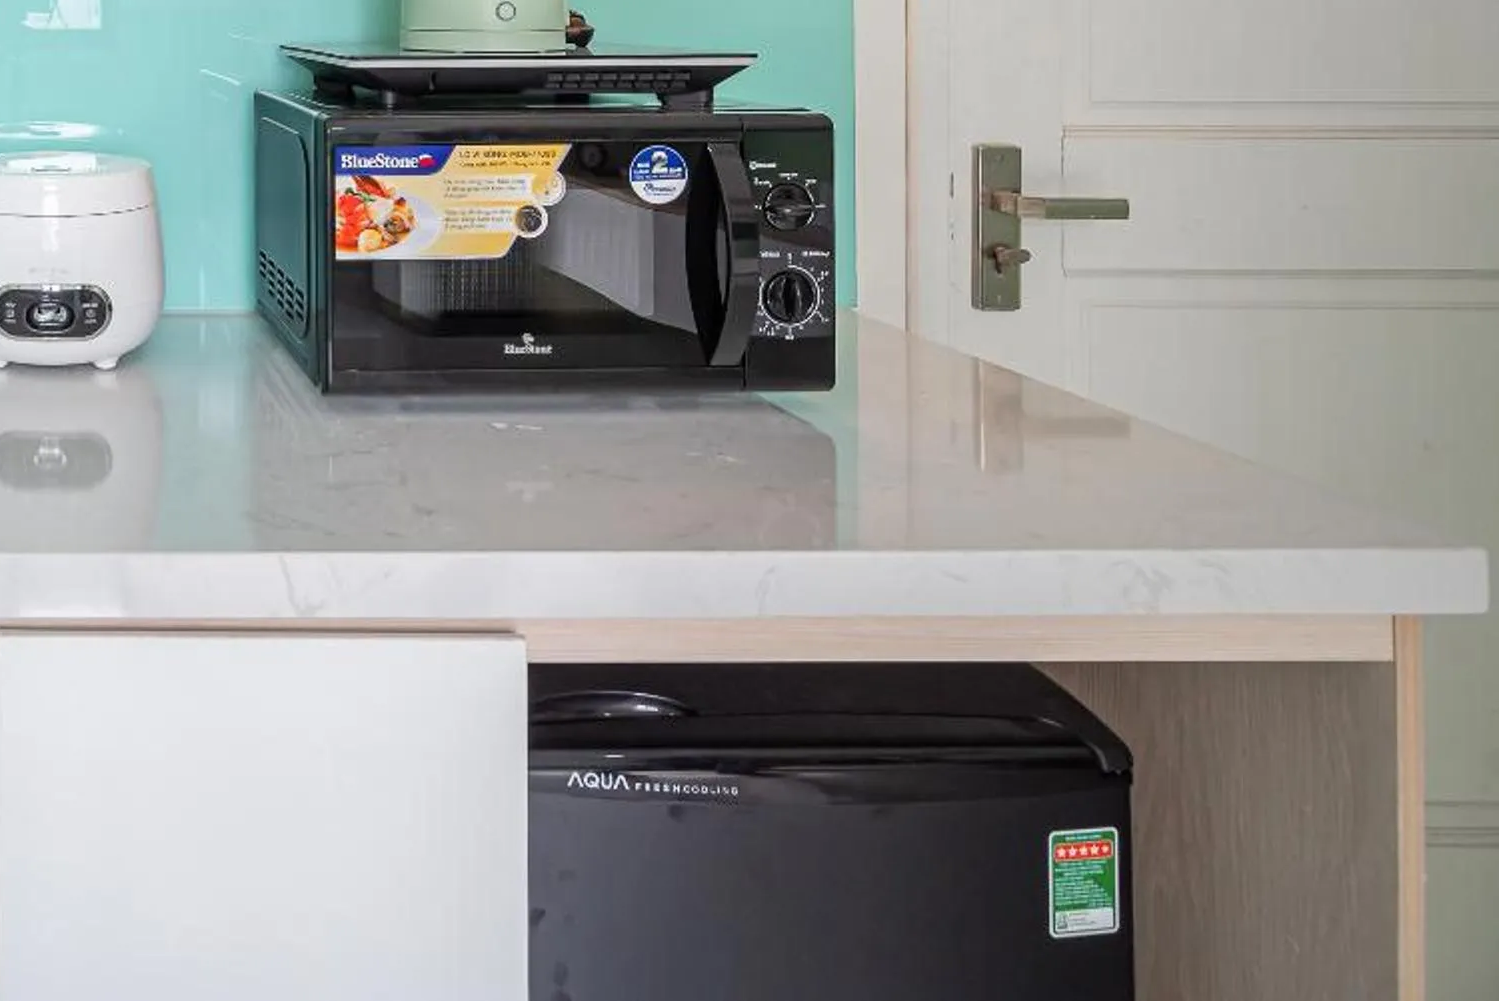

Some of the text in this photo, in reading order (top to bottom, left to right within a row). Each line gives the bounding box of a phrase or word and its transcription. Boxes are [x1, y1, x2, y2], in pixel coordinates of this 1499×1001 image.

[341, 153, 419, 169] BlueStone
[651, 151, 668, 174] 2
[567, 772, 629, 790] AQUA
